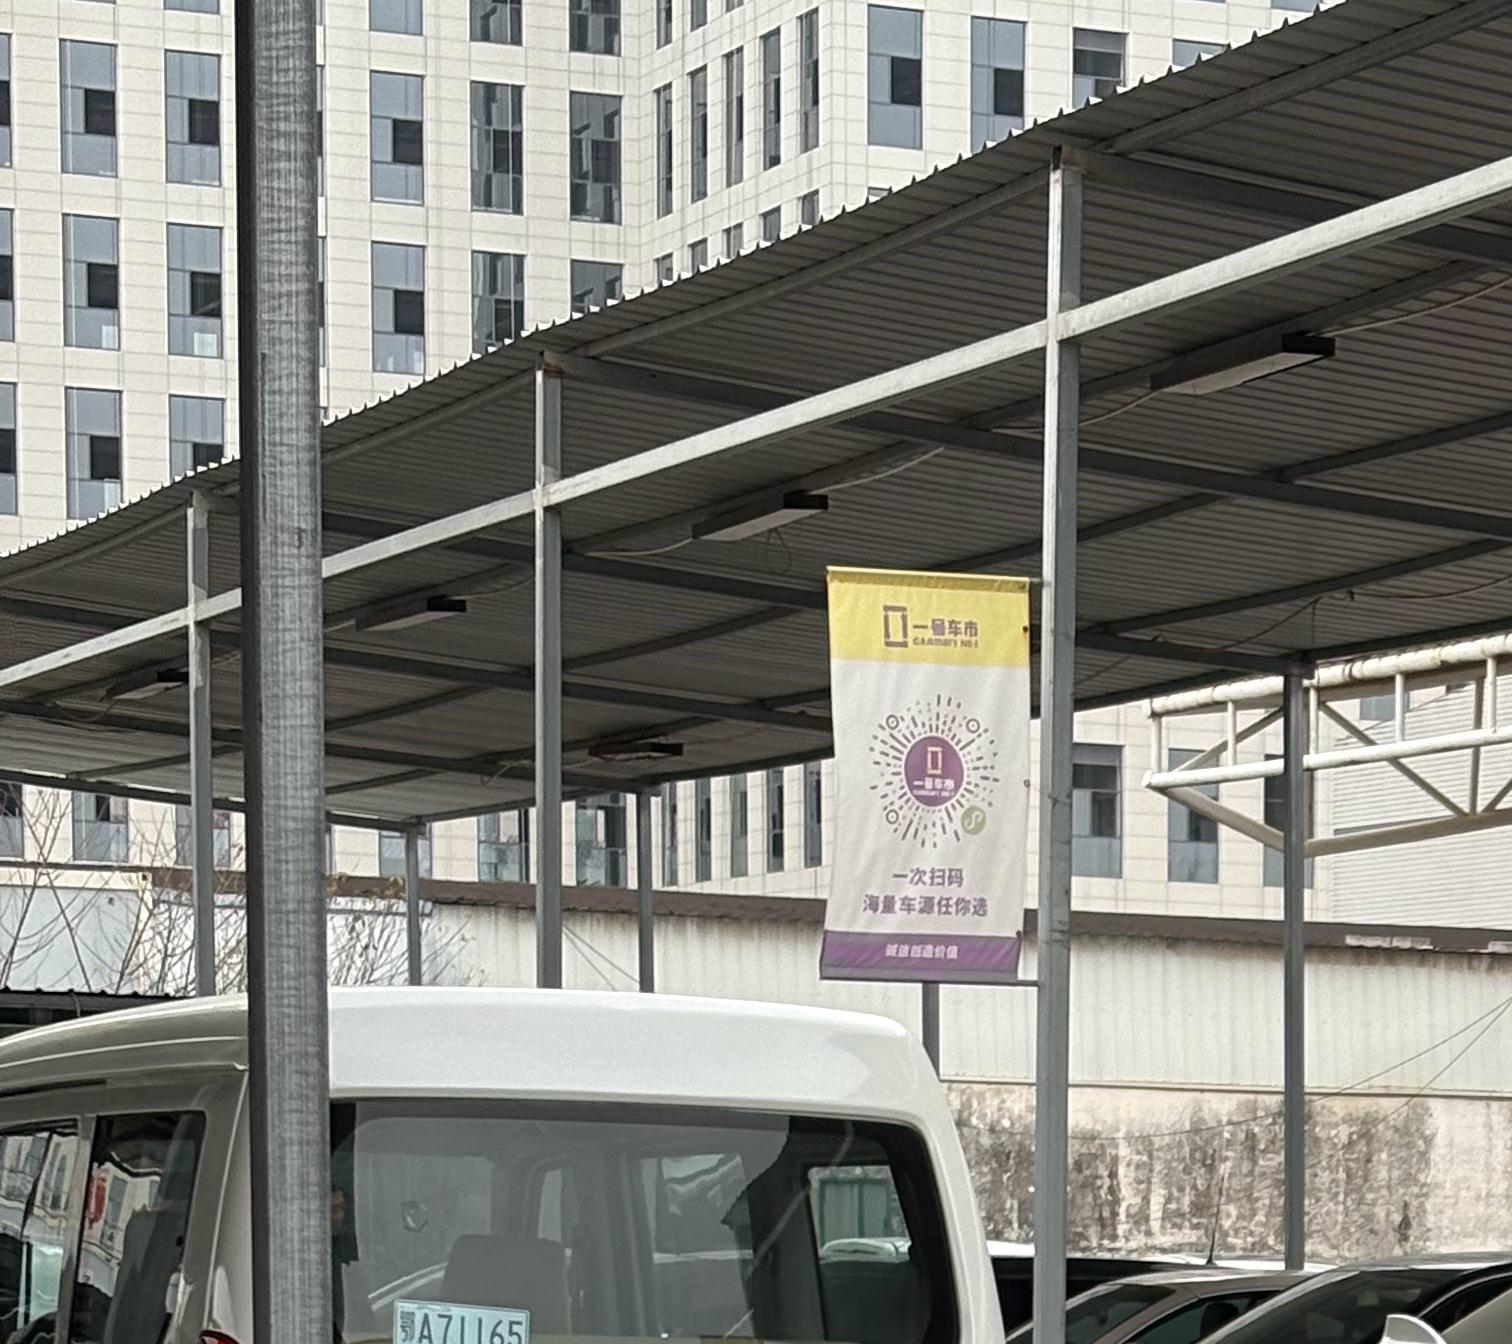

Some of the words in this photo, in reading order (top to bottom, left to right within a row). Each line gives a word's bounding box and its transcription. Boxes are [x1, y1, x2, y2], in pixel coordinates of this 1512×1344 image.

[912, 618, 978, 638] 一号车市
[892, 867, 964, 888] 一次扫码
[862, 893, 988, 918] 海量车源任你选
